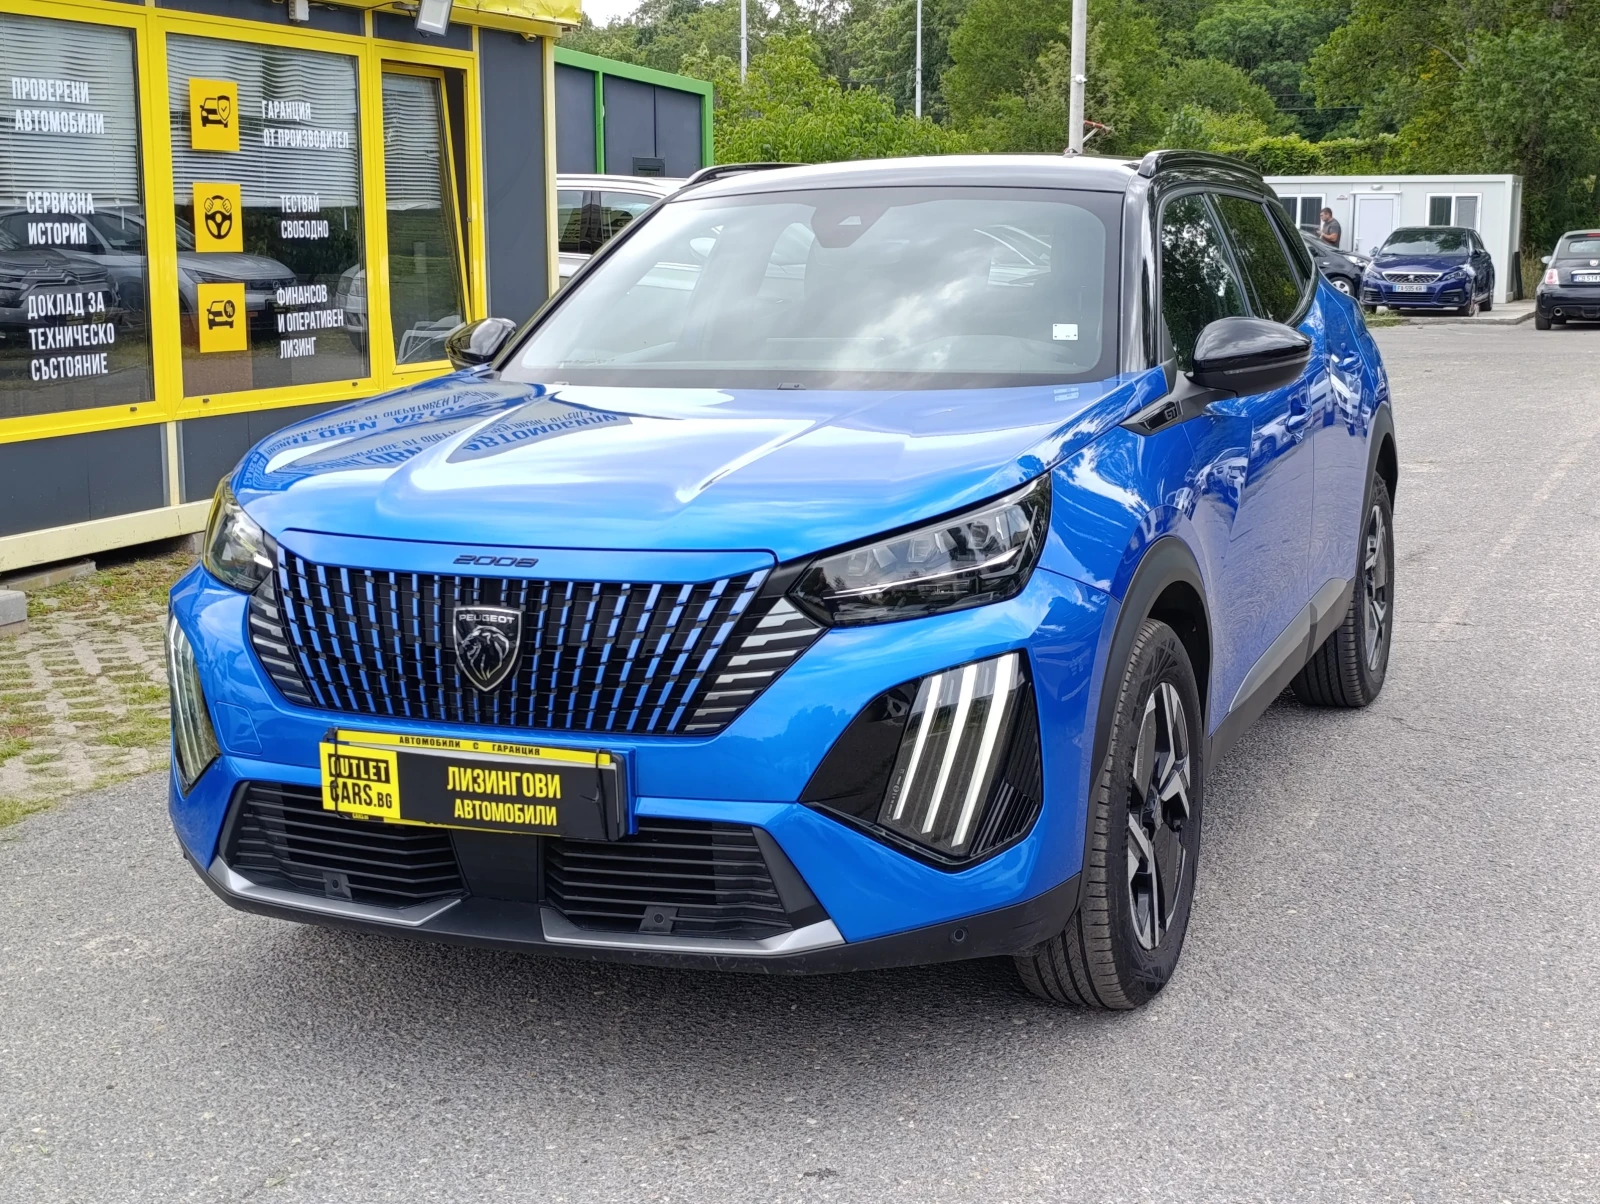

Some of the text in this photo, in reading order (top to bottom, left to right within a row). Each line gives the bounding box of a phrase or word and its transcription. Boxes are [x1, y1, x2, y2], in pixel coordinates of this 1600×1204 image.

[11, 77, 90, 104] ПРОВЕРЕНИ
[15, 109, 105, 135] АВТОМОБИЛИ
[262, 100, 312, 121] ГАРАНЦИЯ
[263, 128, 349, 150] ОТ ПРОИЗВОДИТЕЛ
[26, 191, 95, 215] СЕРВИЗНА
[280, 192, 321, 214] ТЕСТВАЙ
[28, 222, 88, 245] ИСТОРИЯ
[281, 220, 330, 240] СВОБОДНО
[27, 293, 85, 320] ДОКЛАД
[88, 291, 105, 313] ЗА
[276, 284, 329, 307] ФИНАНСОВ
[277, 309, 344, 334] И ОПЕРАТИВЕН
[29, 323, 115, 351] ТЕХНИЧЕСКО
[280, 337, 317, 360] ЛИЗИНГ
[31, 353, 109, 381] СЪСТОЯНИЕ
[1164, 406, 1176, 421] GT
[453, 555, 539, 568] 2008
[459, 614, 515, 624] PEUGEOT
[399, 735, 461, 749] АВТОМОБИЛИ
[492, 743, 541, 757] ГАРАНЦИЯ
[330, 755, 388, 781] OUTLET
[447, 765, 562, 799] ЛИЗИНГОВИ
[330, 782, 393, 809] CARS.BG
[454, 798, 558, 827] АВТОМОБИЛИ
